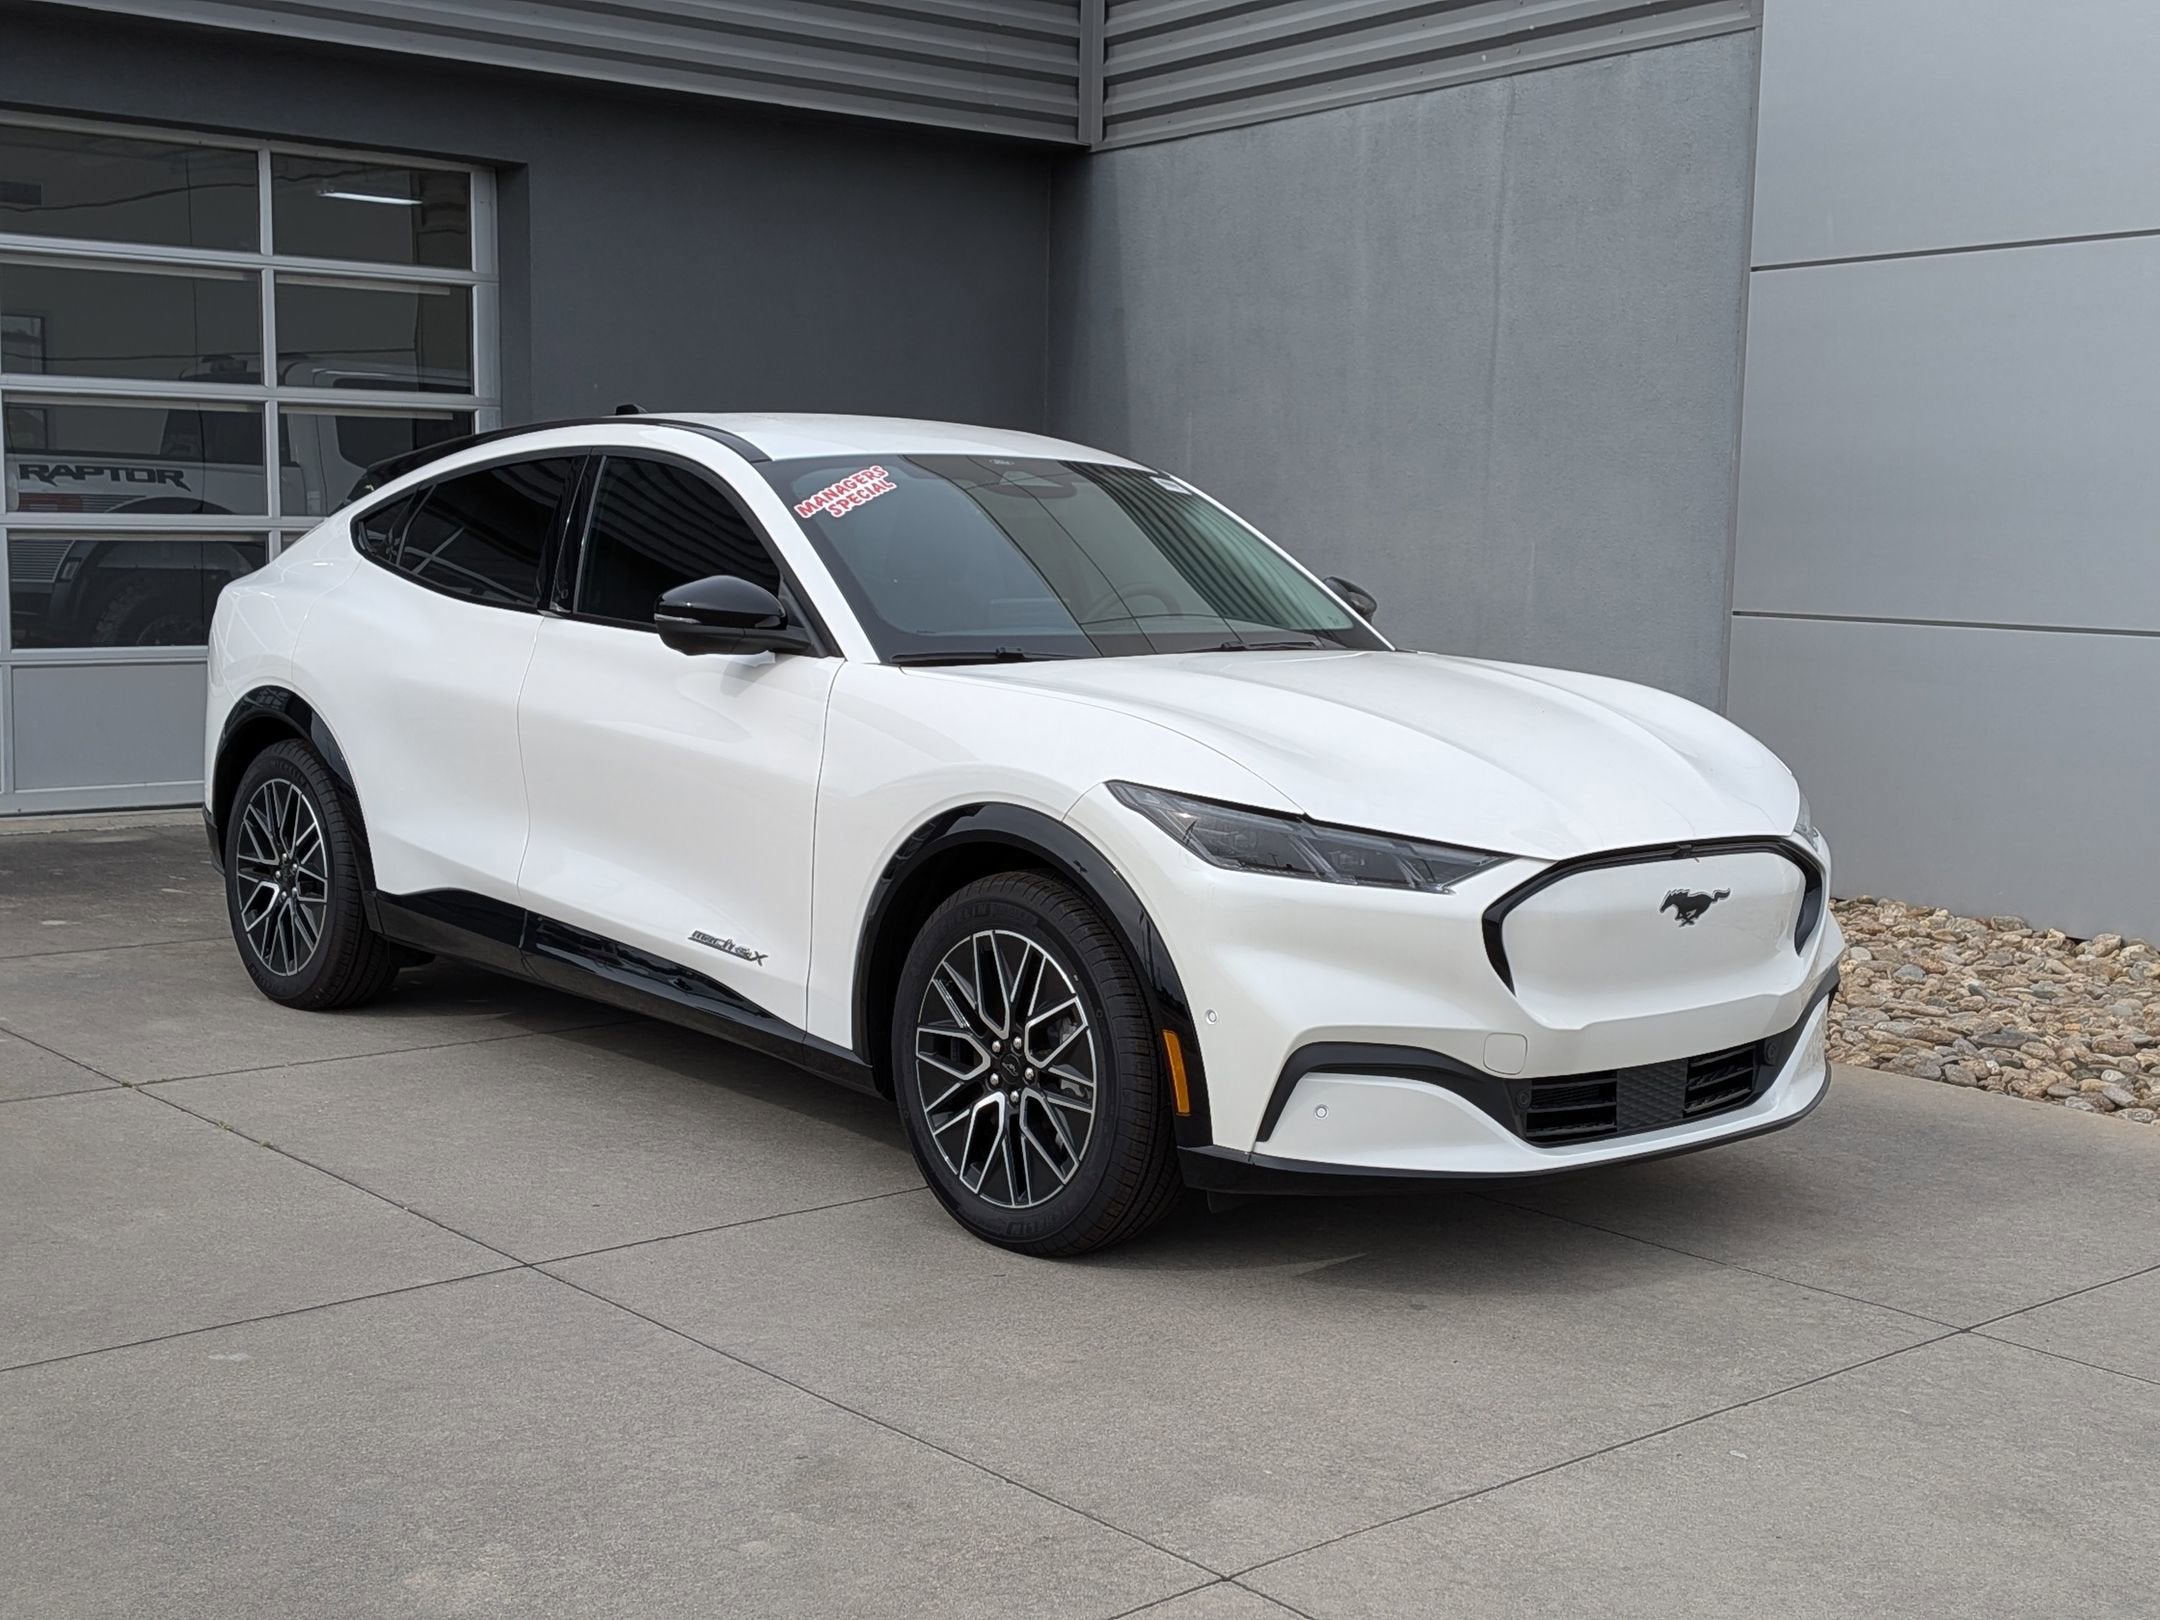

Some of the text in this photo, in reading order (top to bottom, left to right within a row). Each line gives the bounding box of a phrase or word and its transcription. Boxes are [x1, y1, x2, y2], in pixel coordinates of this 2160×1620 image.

[18, 464, 192, 493] RAPTOR
[797, 465, 888, 517] MANAGERS
[827, 480, 895, 517] SPECIAL
